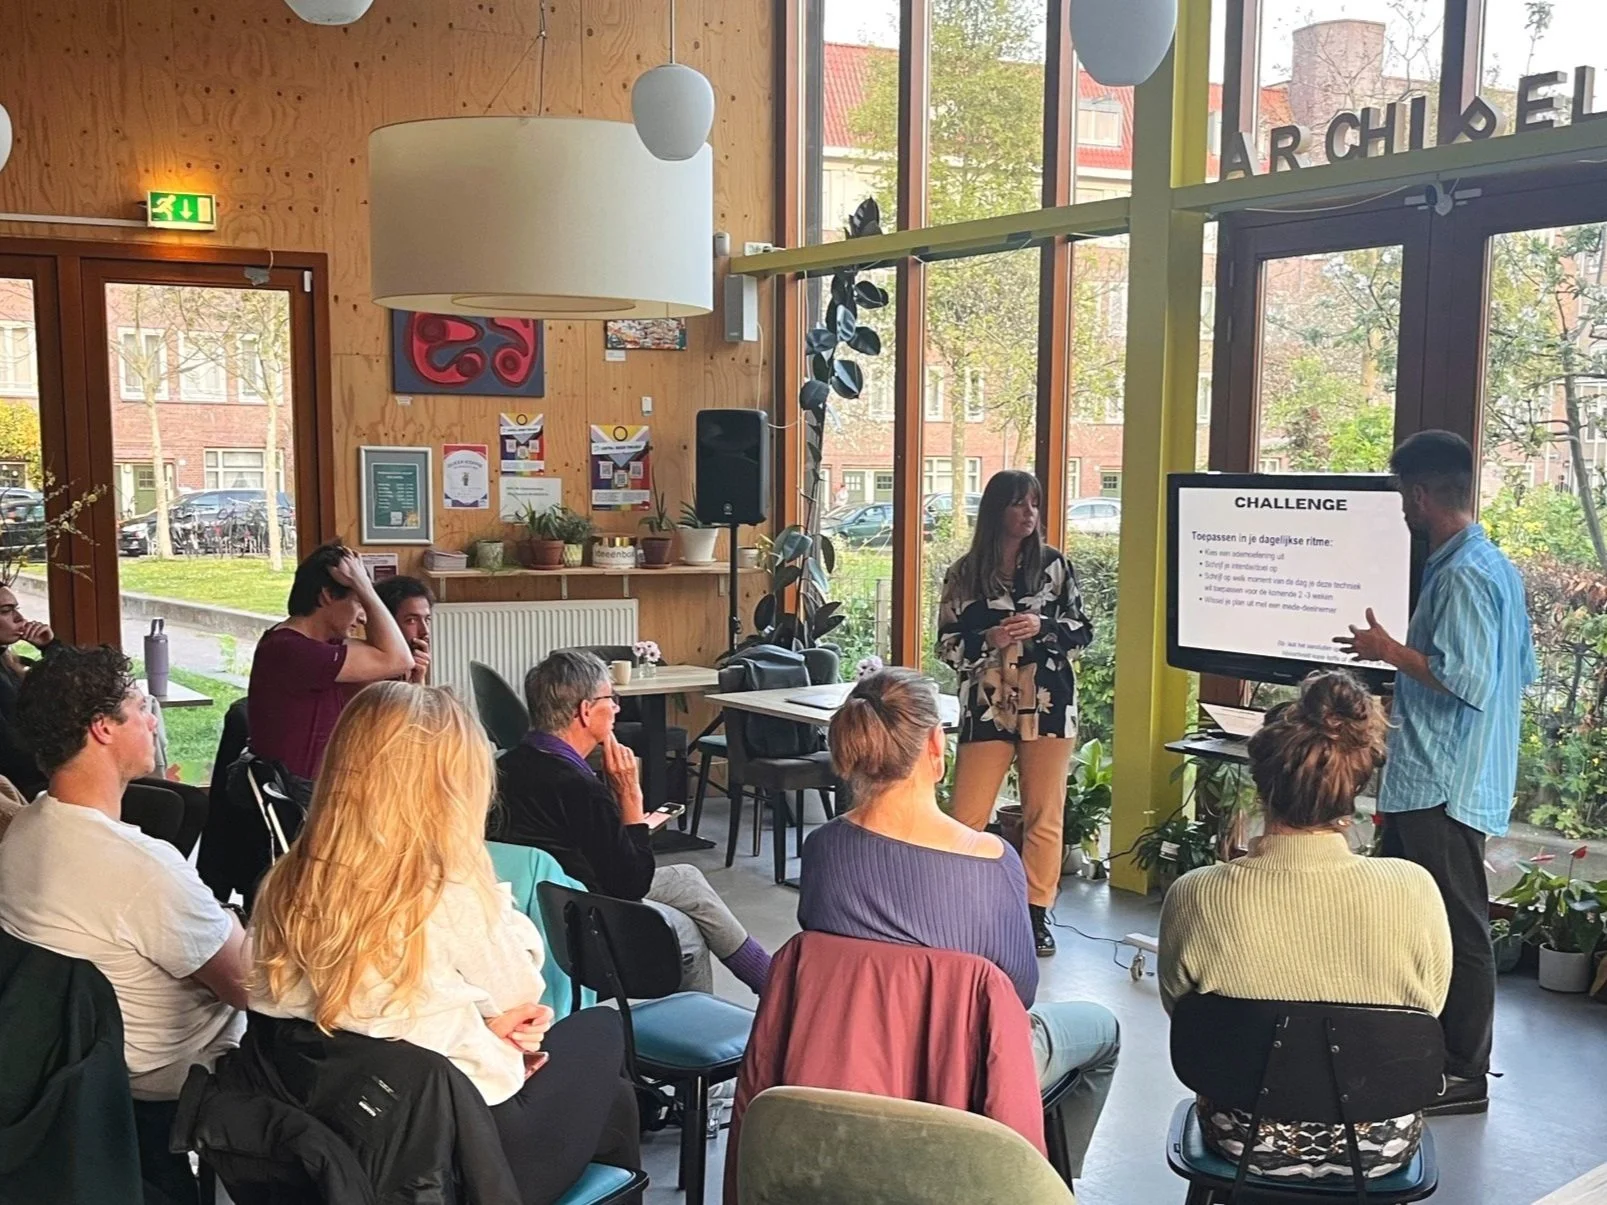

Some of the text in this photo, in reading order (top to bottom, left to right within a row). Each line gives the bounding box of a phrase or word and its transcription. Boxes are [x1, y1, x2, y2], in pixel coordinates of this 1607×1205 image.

[1220, 65, 1607, 181] ARCHIPEL
[1235, 496, 1347, 511] CHALLENGE
[1192, 531, 1333, 547] Toepassen in je dagelijkse ritme:
[1247, 575, 1272, 584] moment
[1294, 578, 1307, 588] dag
